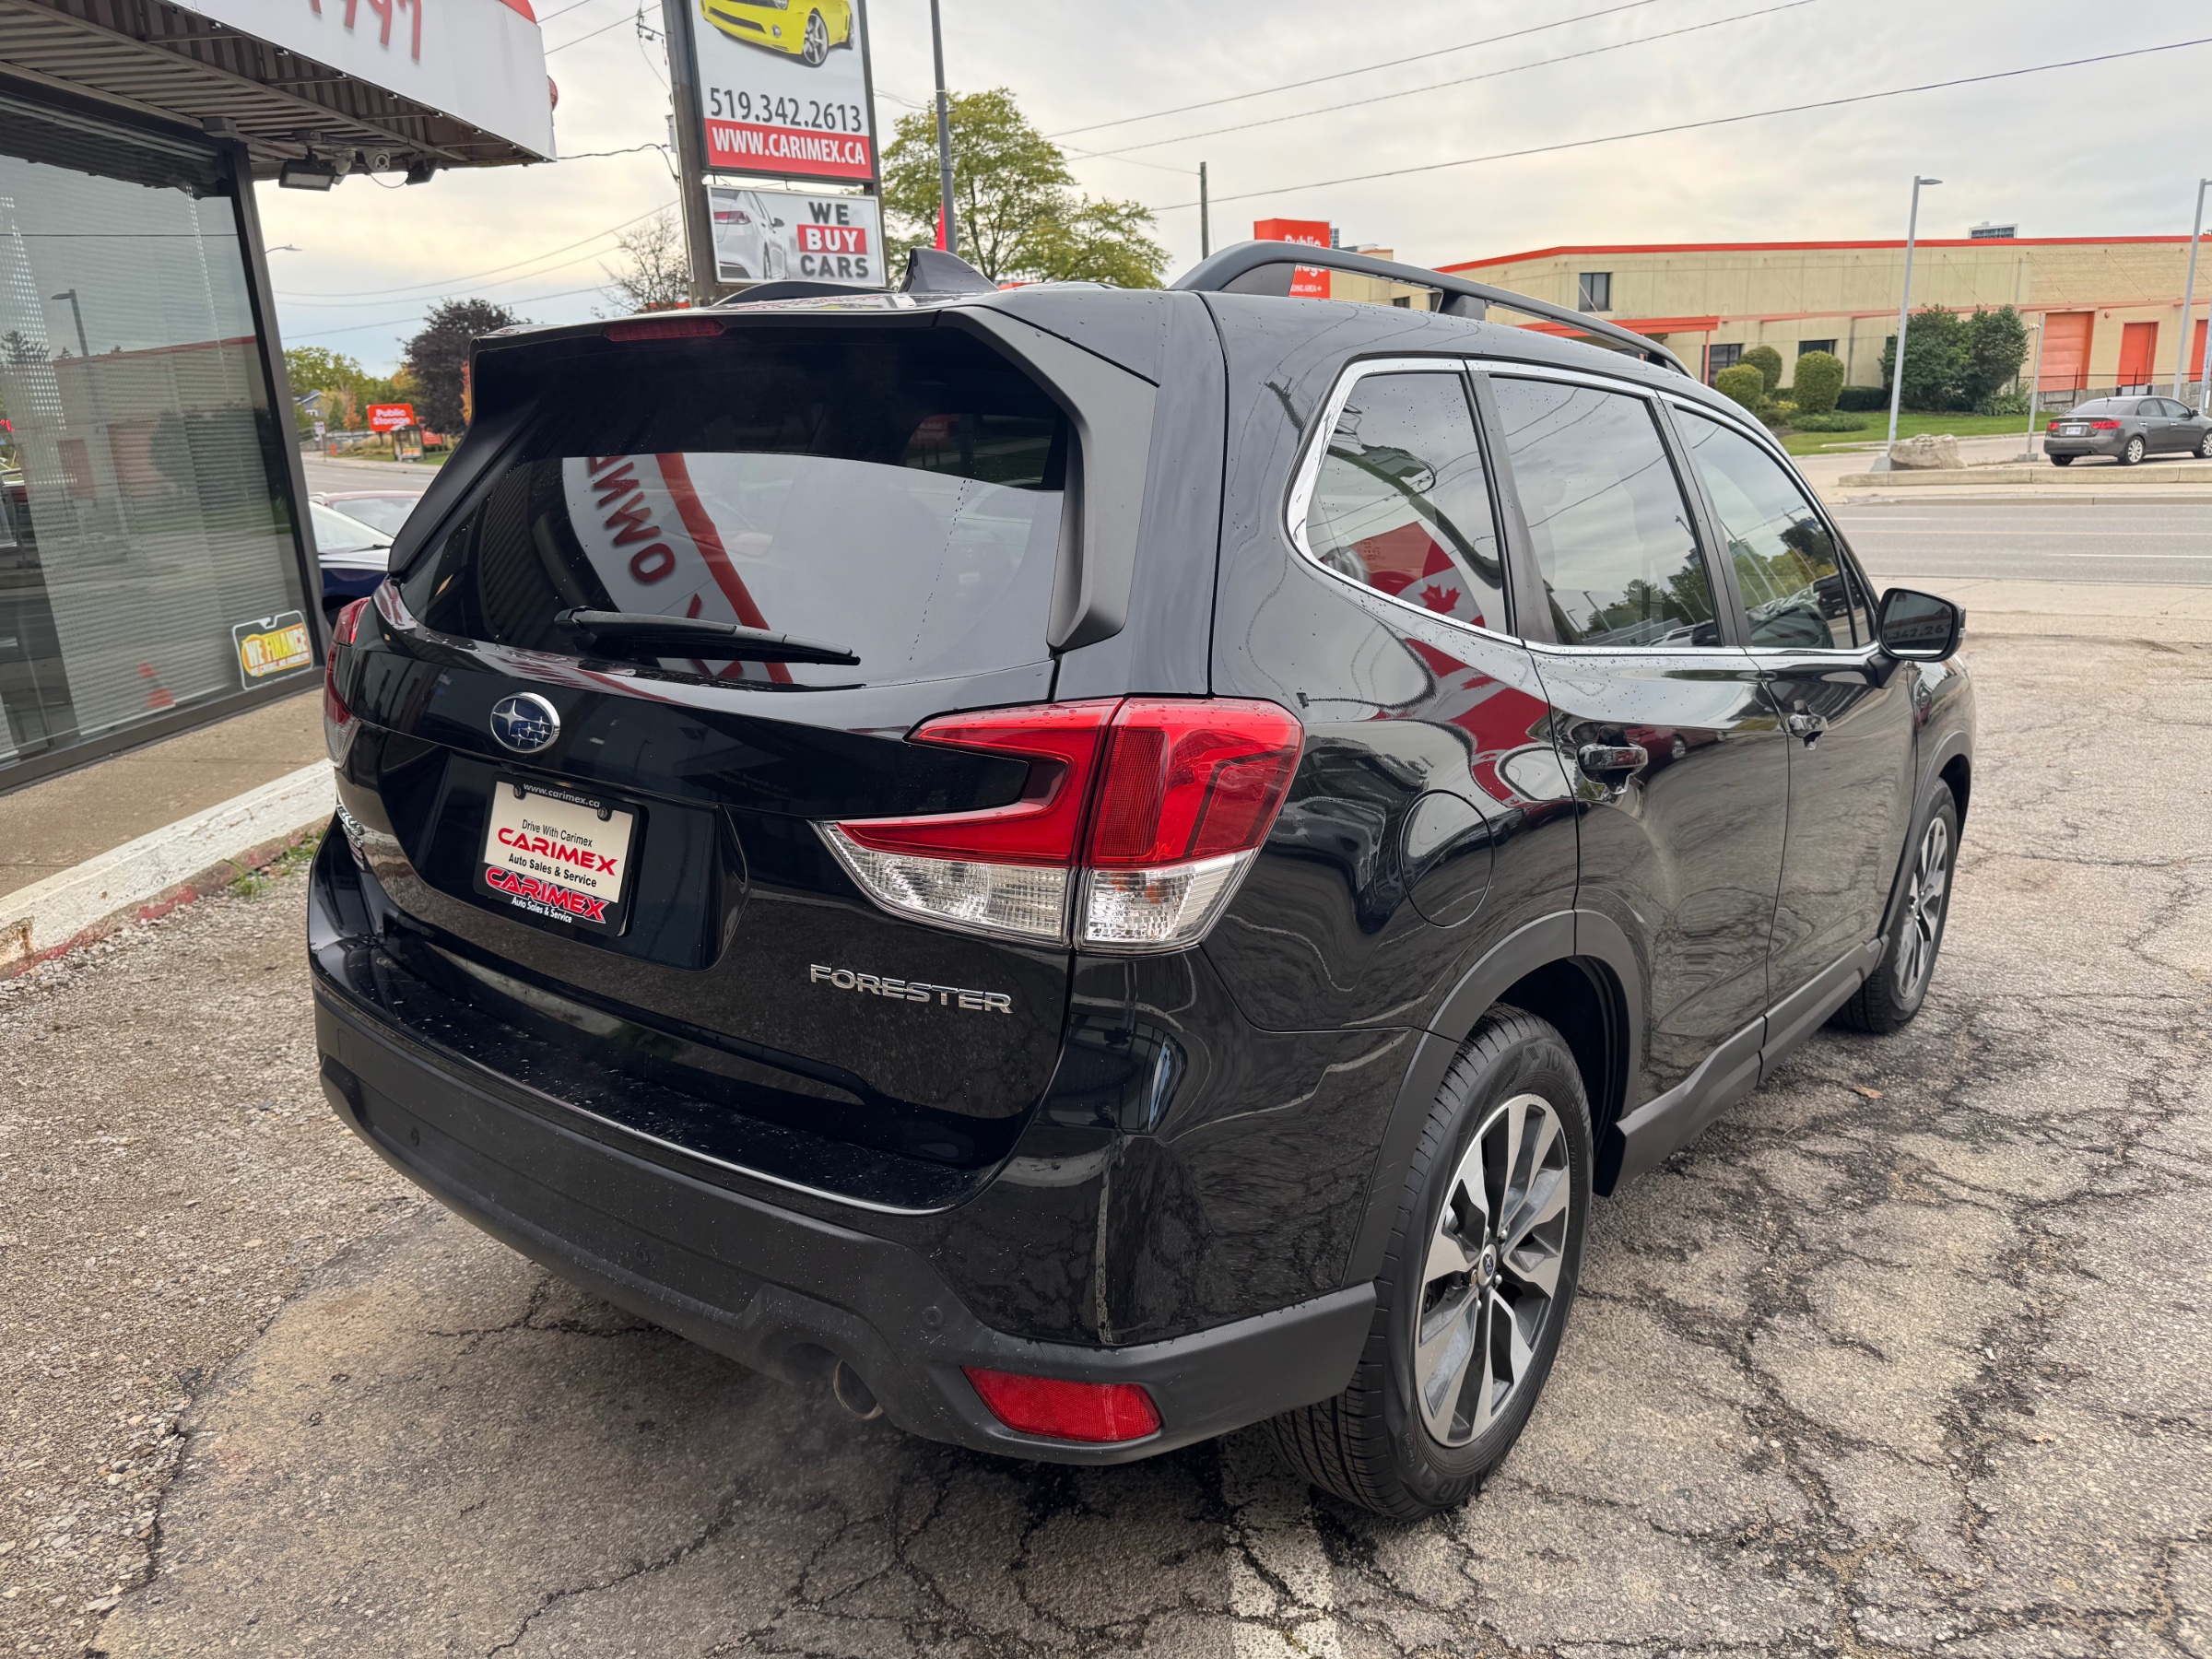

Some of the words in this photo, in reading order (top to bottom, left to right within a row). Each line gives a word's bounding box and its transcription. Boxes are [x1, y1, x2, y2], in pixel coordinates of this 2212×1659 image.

[710, 87, 862, 133] 519.342.2613
[712, 126, 866, 166] WWW.CARIMEX.CA
[808, 201, 850, 226] WE
[805, 228, 858, 253] BUY
[800, 254, 869, 278] CARS
[372, 416, 411, 426] Storage
[375, 408, 406, 418] Public
[245, 639, 265, 668] WE
[264, 627, 309, 663] FINANCE
[523, 783, 601, 807] www.carimex.ca
[522, 818, 541, 833] Drive
[542, 824, 559, 839] With
[559, 830, 594, 848] Carimex
[498, 827, 618, 877] CARIMEX
[508, 853, 527, 867] Auto
[529, 859, 552, 875] Sales
[554, 866, 560, 877] &
[563, 869, 597, 888] Service
[486, 866, 608, 923] CARIMEX
[511, 896, 526, 909] Auto
[527, 900, 544, 914] Sales
[544, 906, 550, 916] &
[550, 909, 572, 924] Service
[810, 963, 1014, 1015] FORESTER
